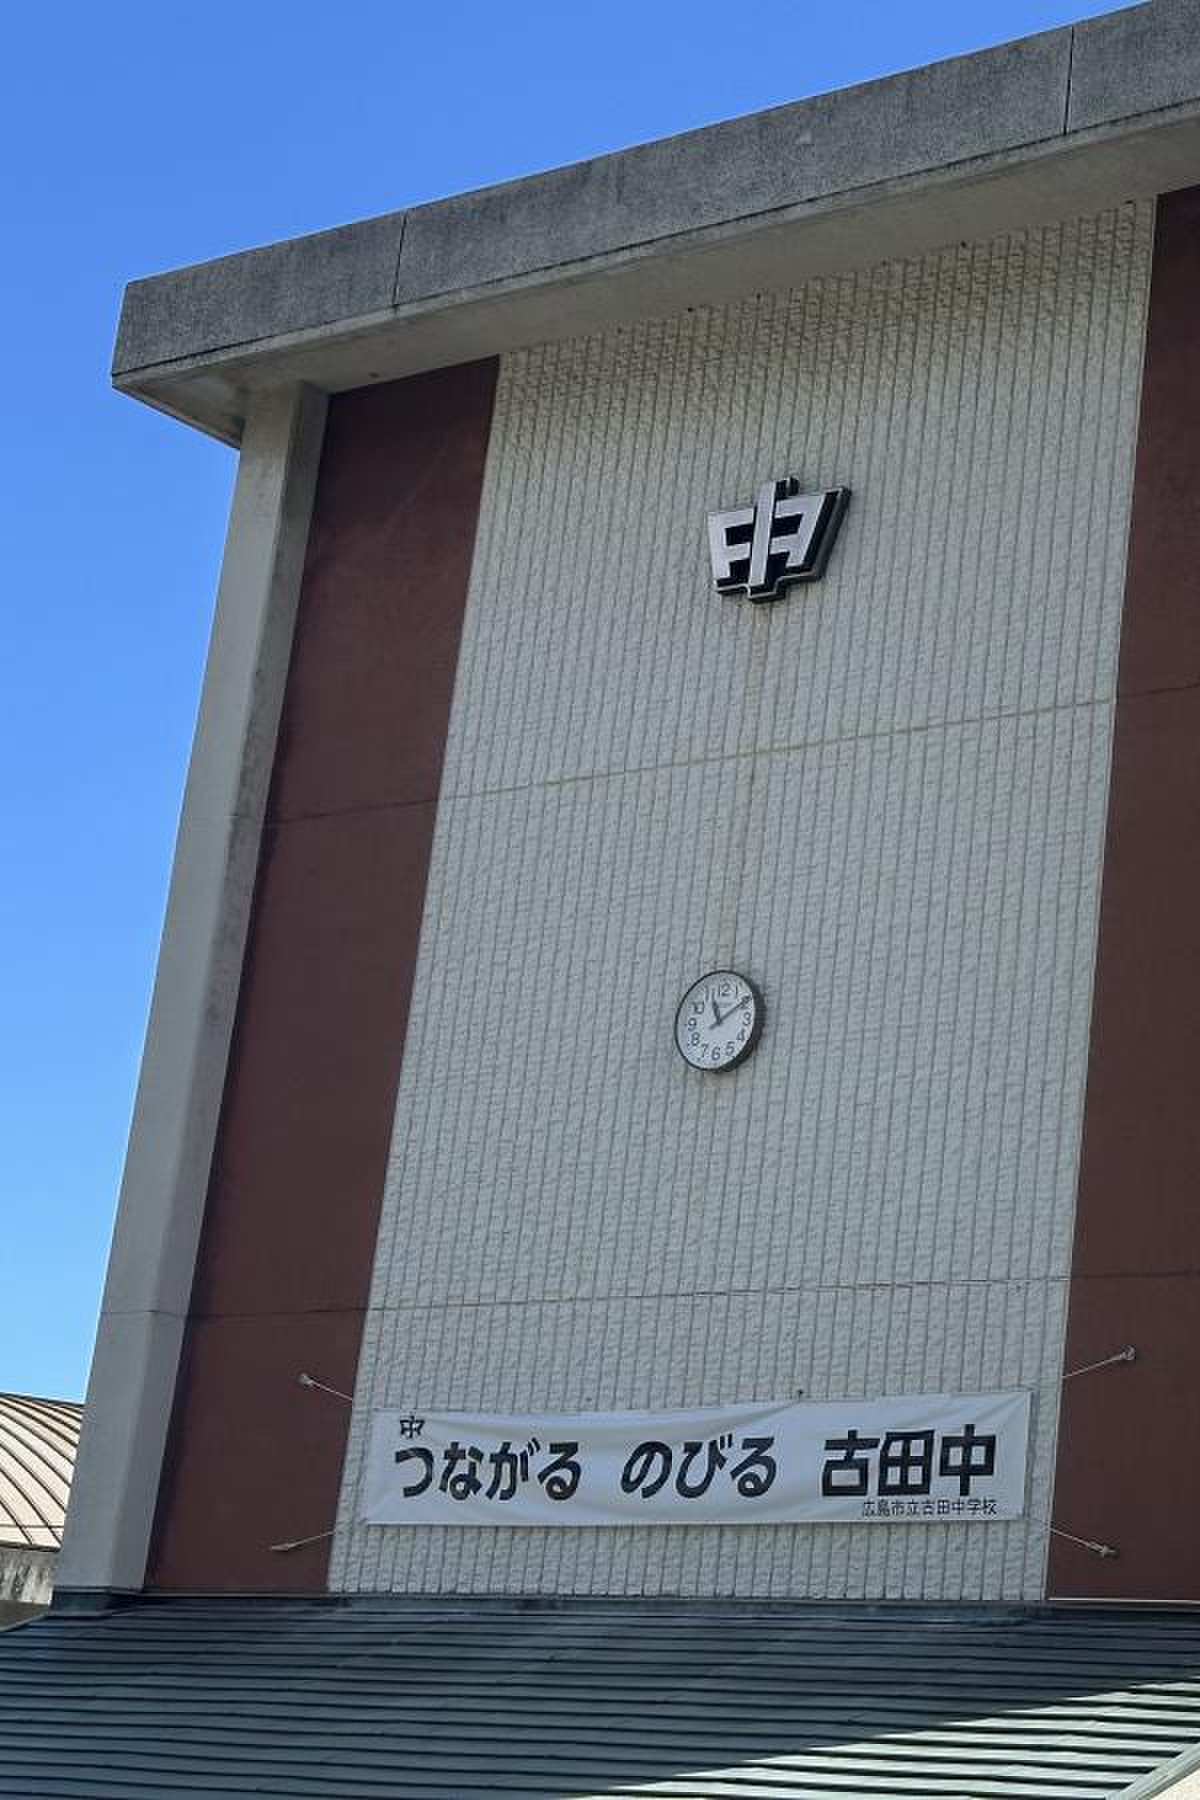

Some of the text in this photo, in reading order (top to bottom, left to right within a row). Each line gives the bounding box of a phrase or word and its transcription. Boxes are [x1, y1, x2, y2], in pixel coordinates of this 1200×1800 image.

[687, 1017, 697, 1032] 9
[691, 1032, 700, 1047] 8
[736, 1028, 745, 1042] 4
[711, 1046, 721, 1061] 6
[725, 1041, 735, 1056] 5
[395, 1424, 996, 1501] つながる のびる 古田中
[863, 1498, 997, 1517] 広島市立古田中学校
